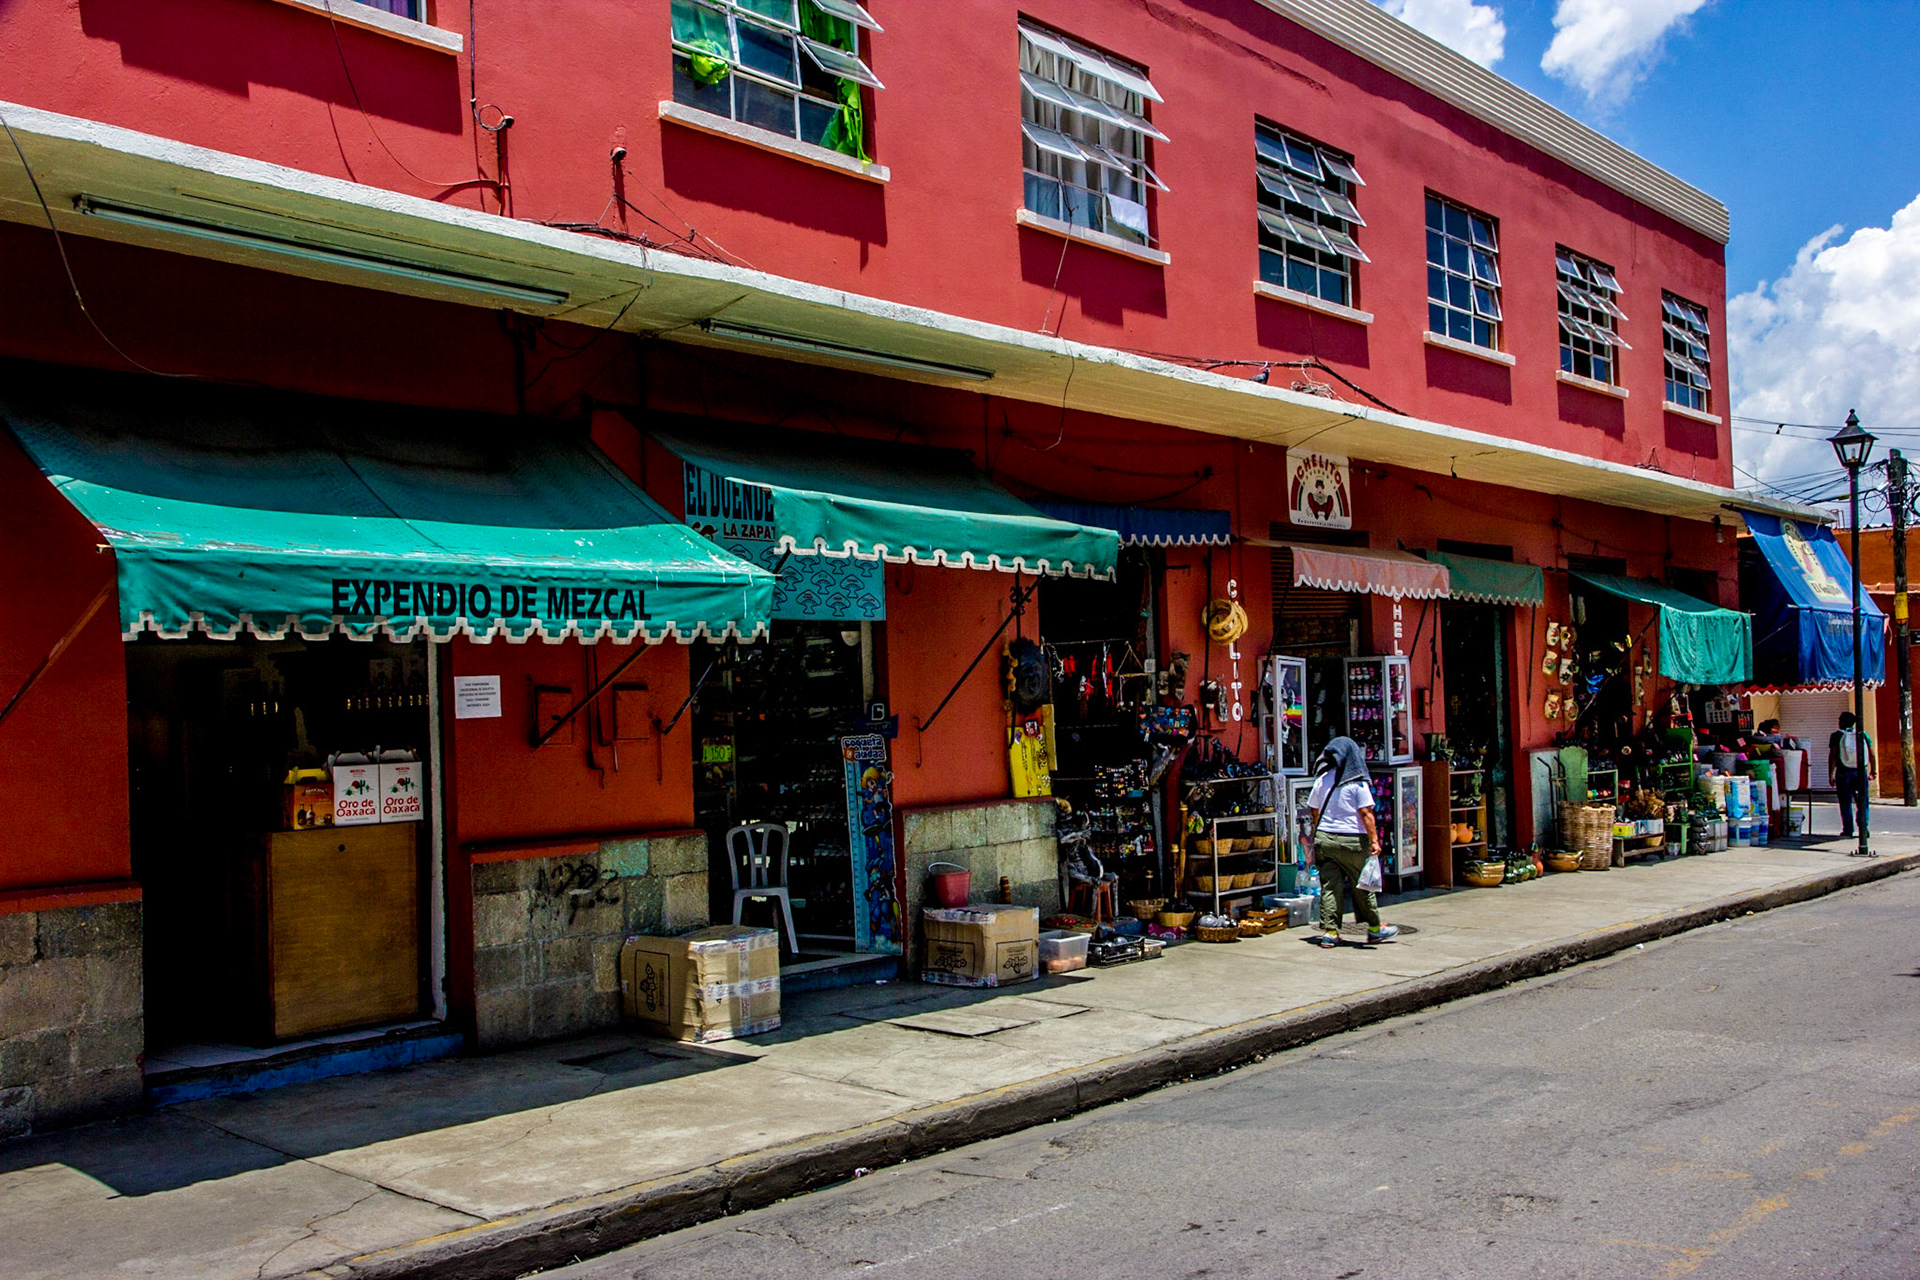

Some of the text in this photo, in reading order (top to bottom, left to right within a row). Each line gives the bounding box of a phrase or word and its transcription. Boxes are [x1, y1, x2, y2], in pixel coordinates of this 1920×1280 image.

[1297, 454, 1342, 485] CHELITO
[686, 462, 774, 522] EL DUENDE
[723, 522, 738, 537] LA
[332, 578, 652, 621] EXPENDIO DE MEZCAL
[338, 799, 374, 809] Oro de
[385, 795, 418, 806] Oro de
[336, 807, 376, 818] Oaxaca
[383, 804, 420, 815] Oaxaca
